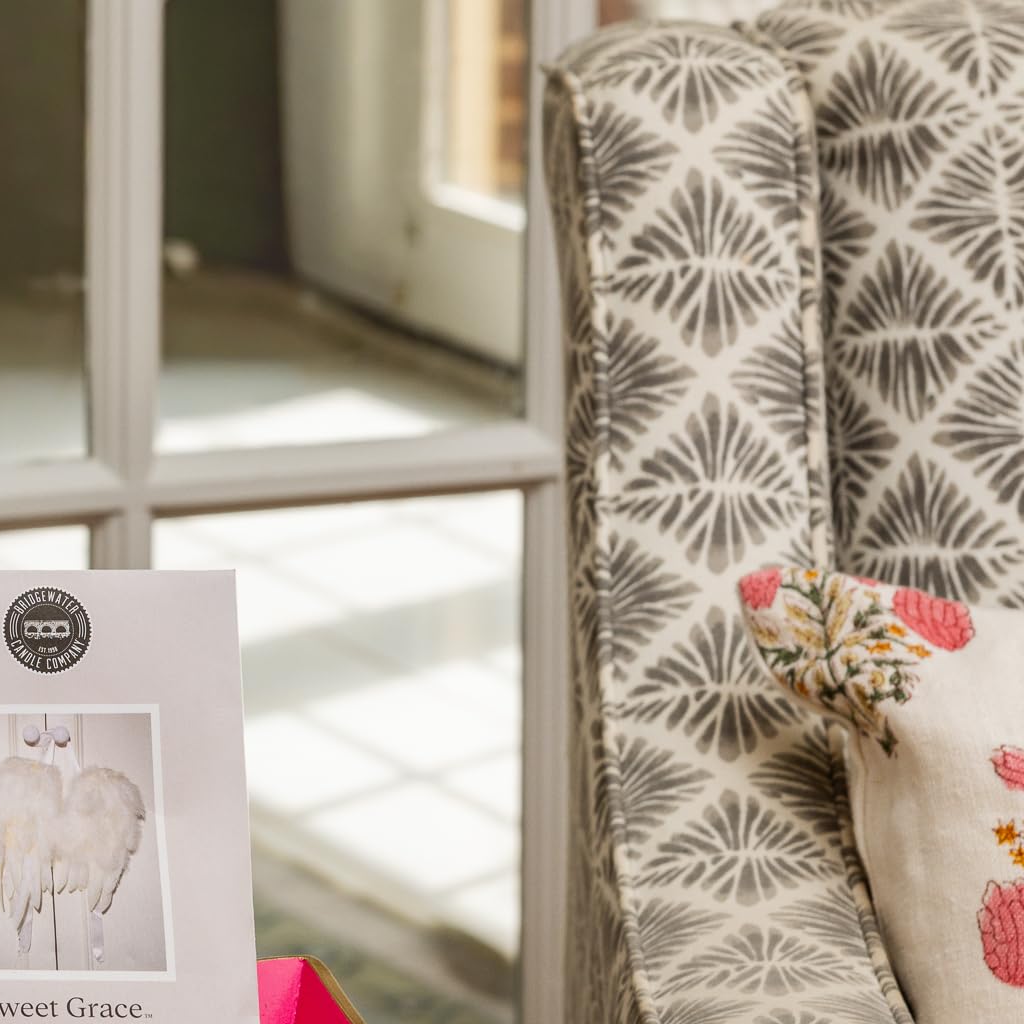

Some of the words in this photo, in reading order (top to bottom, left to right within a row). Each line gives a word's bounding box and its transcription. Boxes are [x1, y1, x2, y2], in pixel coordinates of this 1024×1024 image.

[13, 590, 80, 615] BRIDGEWATER
[10, 639, 43, 669] CANDLE
[46, 637, 85, 670] COMPANY
